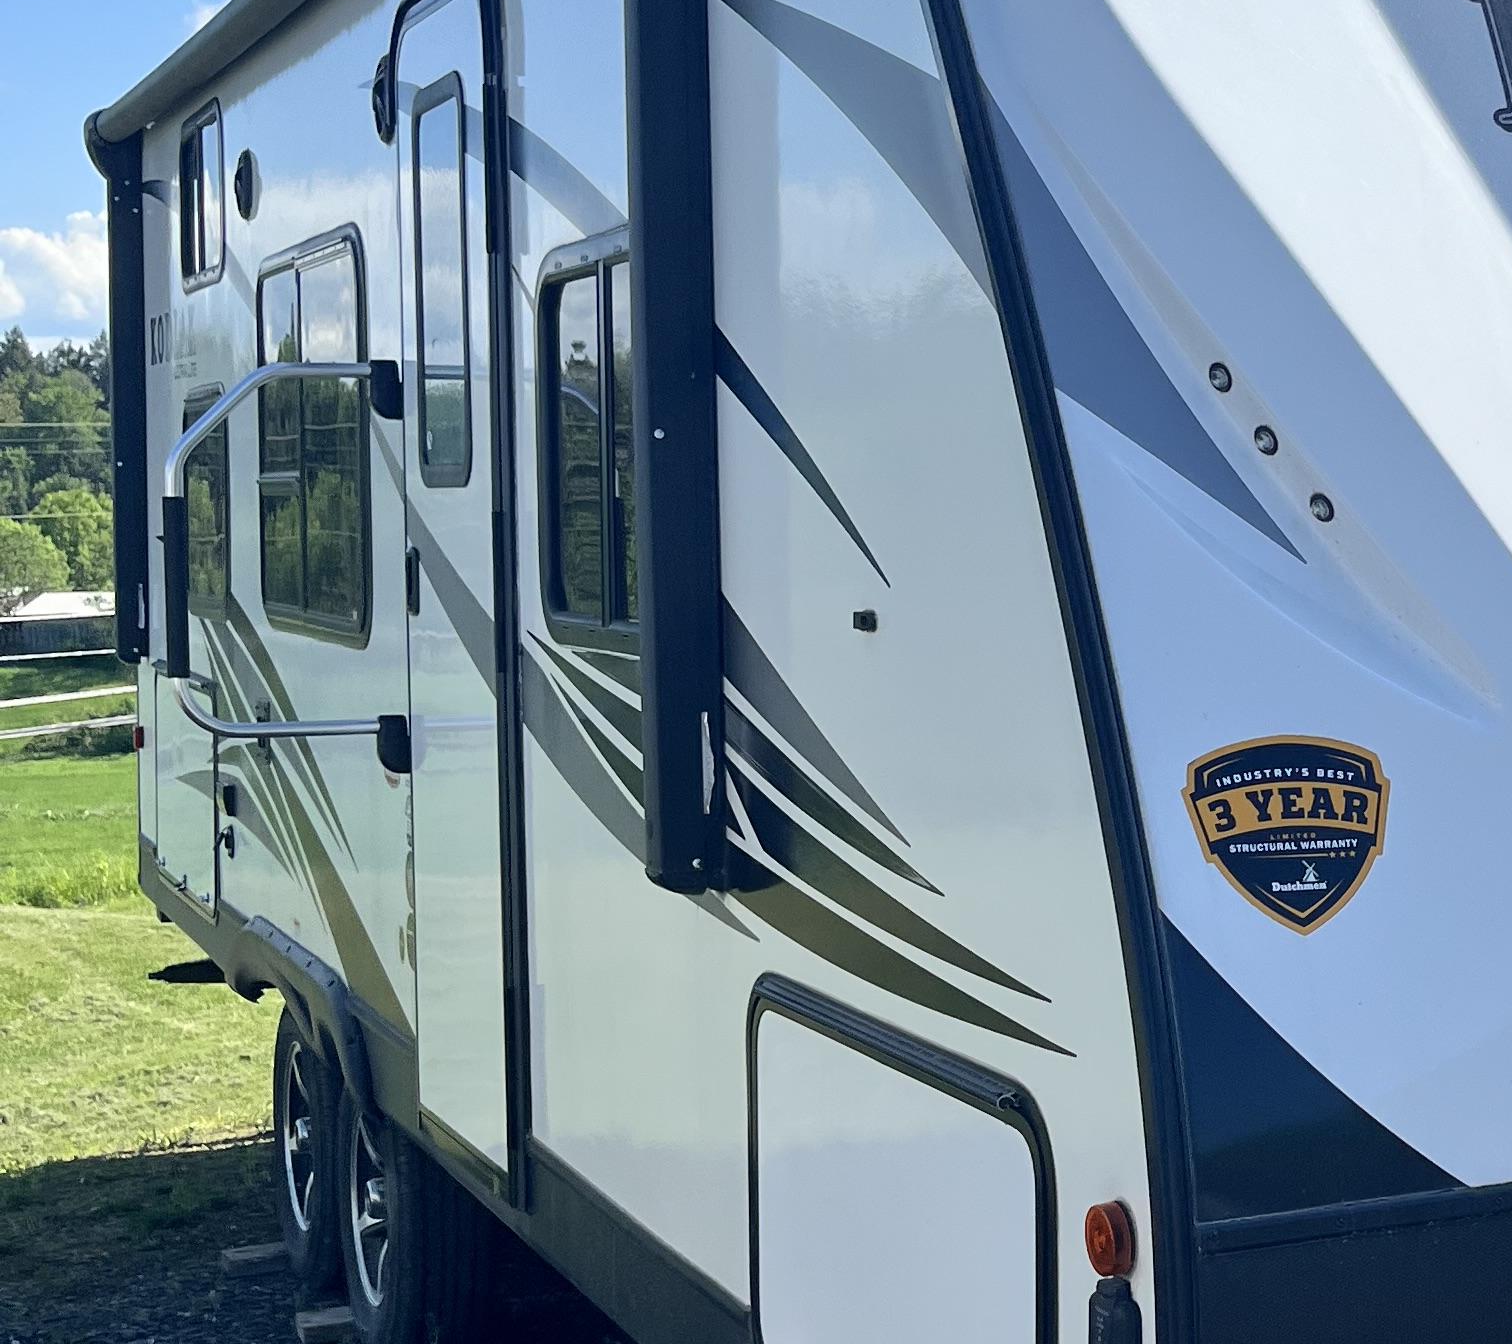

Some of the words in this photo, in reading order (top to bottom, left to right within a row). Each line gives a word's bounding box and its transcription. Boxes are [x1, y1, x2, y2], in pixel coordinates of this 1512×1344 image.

[1215, 767, 1310, 787] INDUSTRY'S
[1316, 768, 1355, 781] BEST
[1207, 798, 1237, 832] 3
[1245, 787, 1369, 824] YEAR
[1229, 840, 1298, 854] STRUCTURAL
[1300, 838, 1358, 850] WARRANTY
[1271, 880, 1327, 892] Dutchmen
